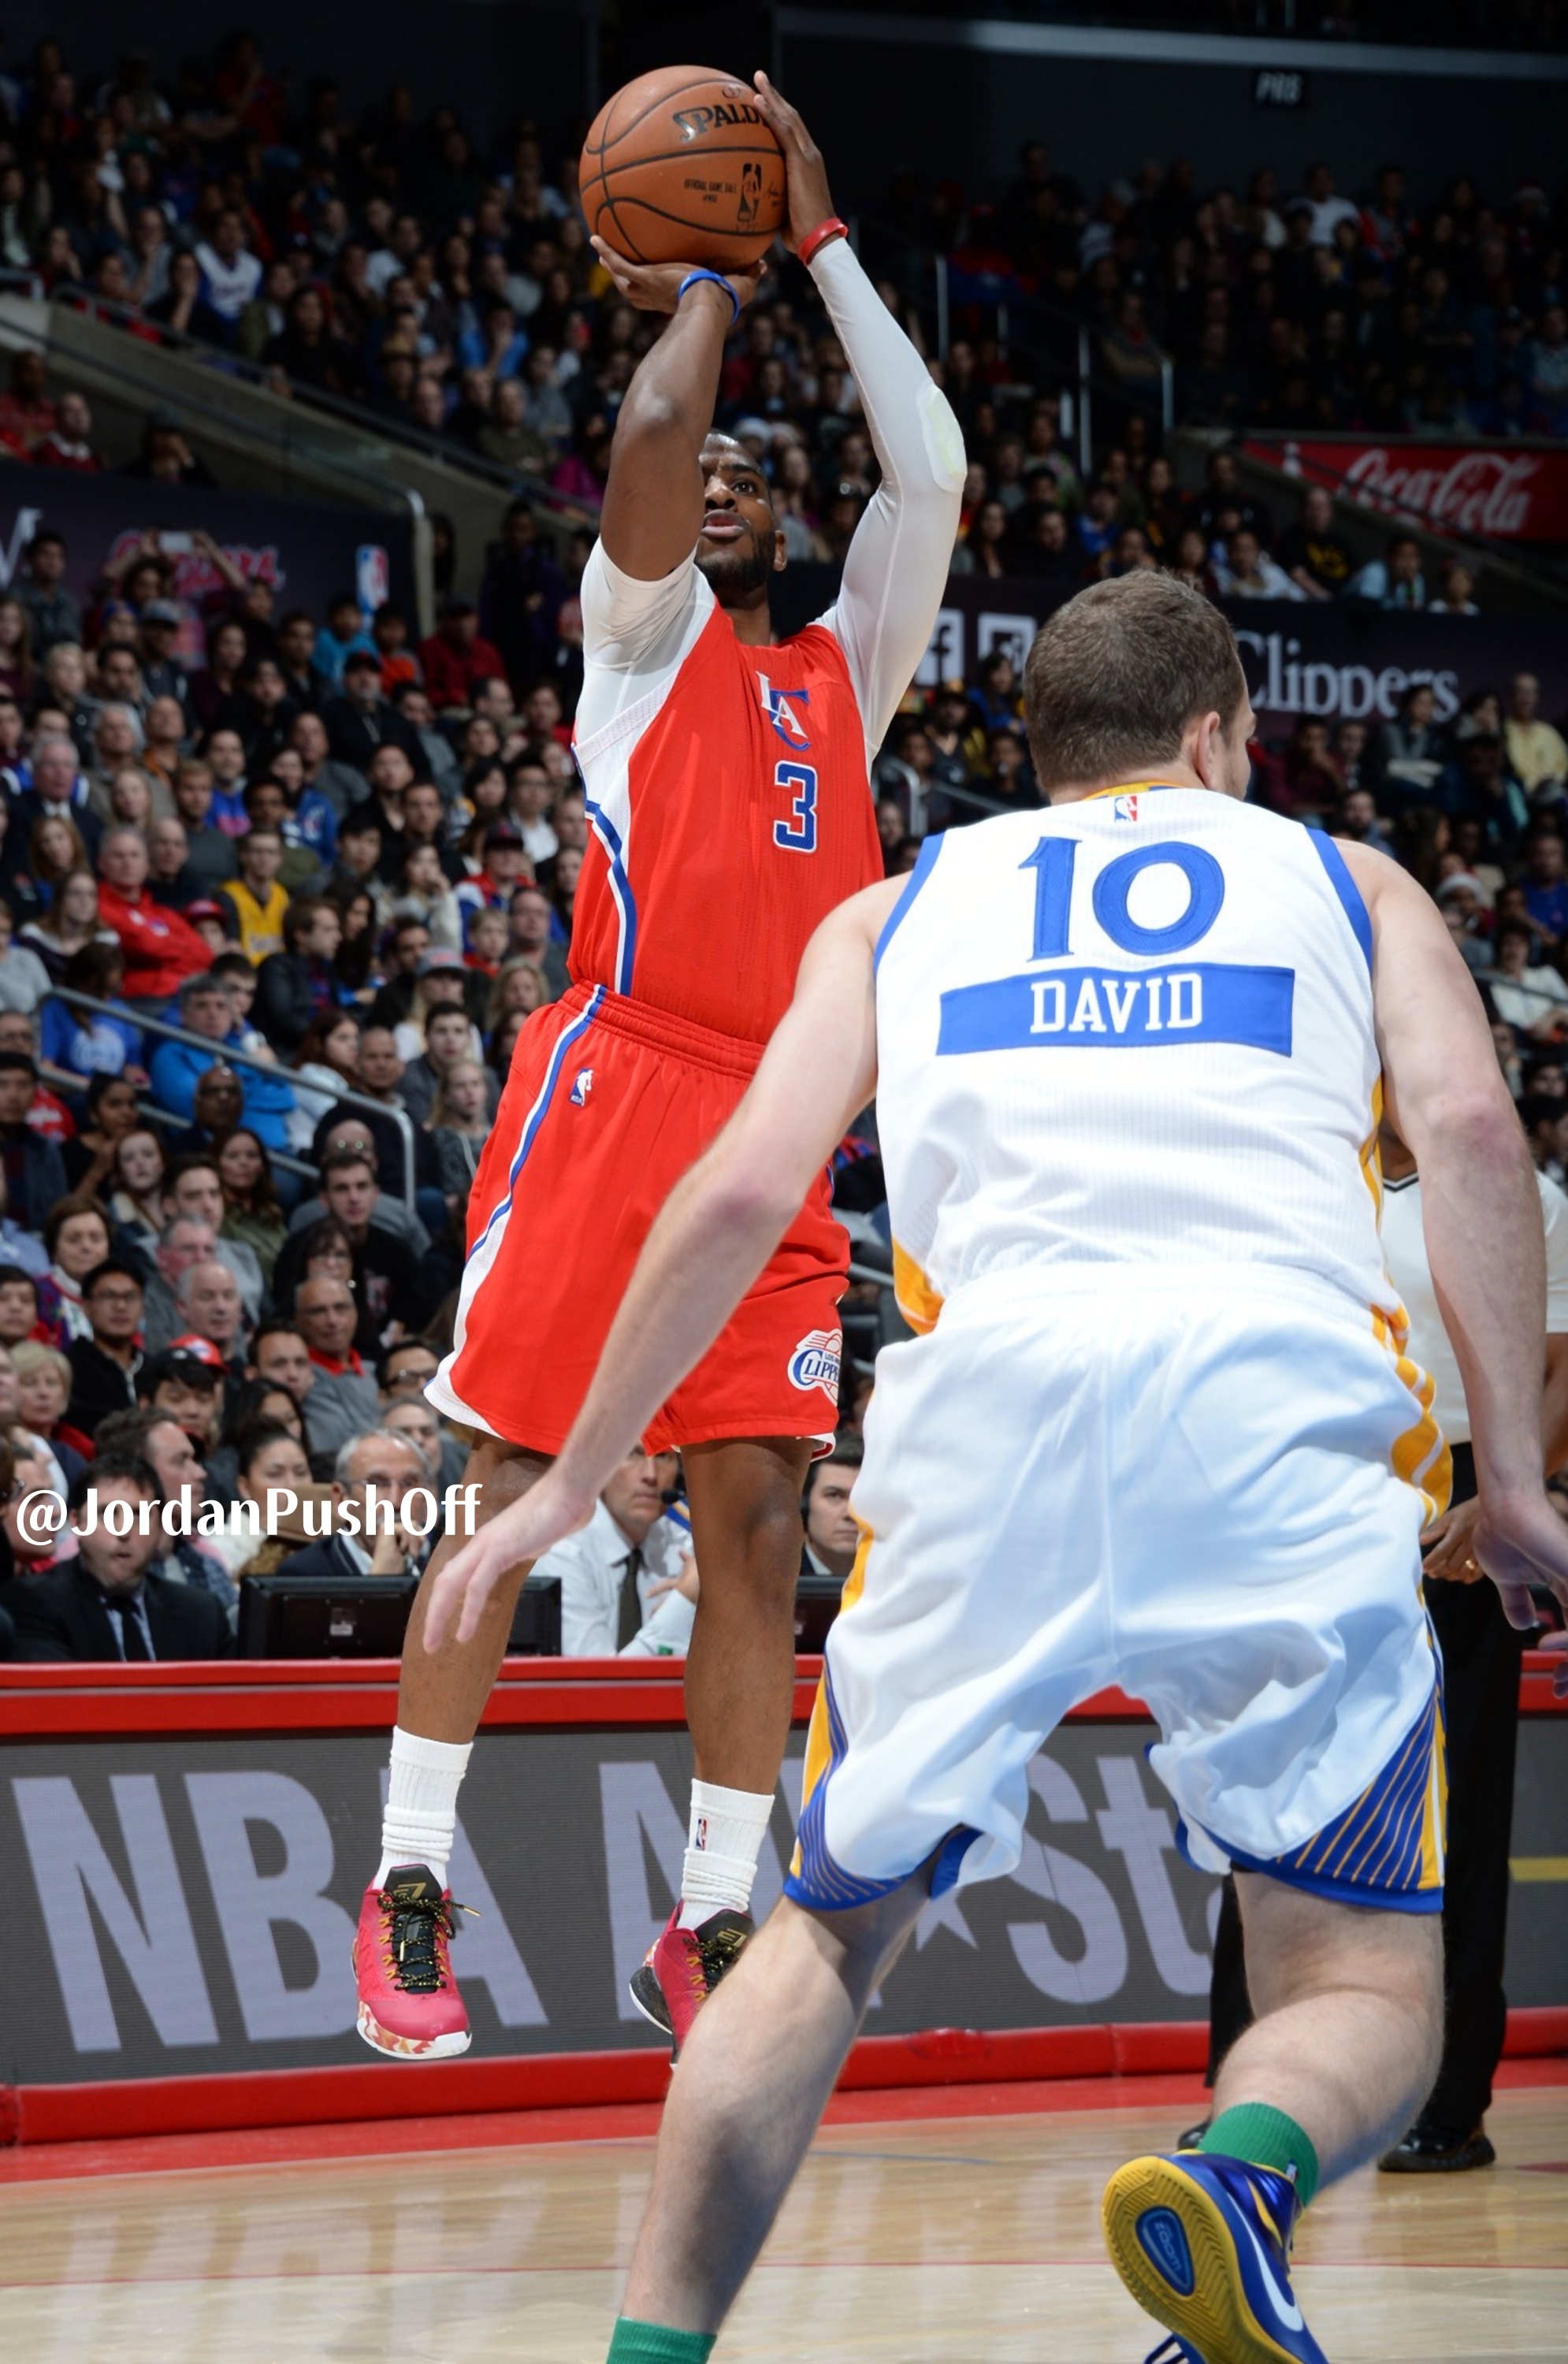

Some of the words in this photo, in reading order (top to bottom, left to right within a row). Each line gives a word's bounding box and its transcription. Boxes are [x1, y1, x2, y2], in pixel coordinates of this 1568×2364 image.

[672, 103, 768, 145] SPALD
[773, 760, 818, 853] 3
[1018, 836, 1225, 962] 10
[1030, 972, 1203, 1034] DAVID
